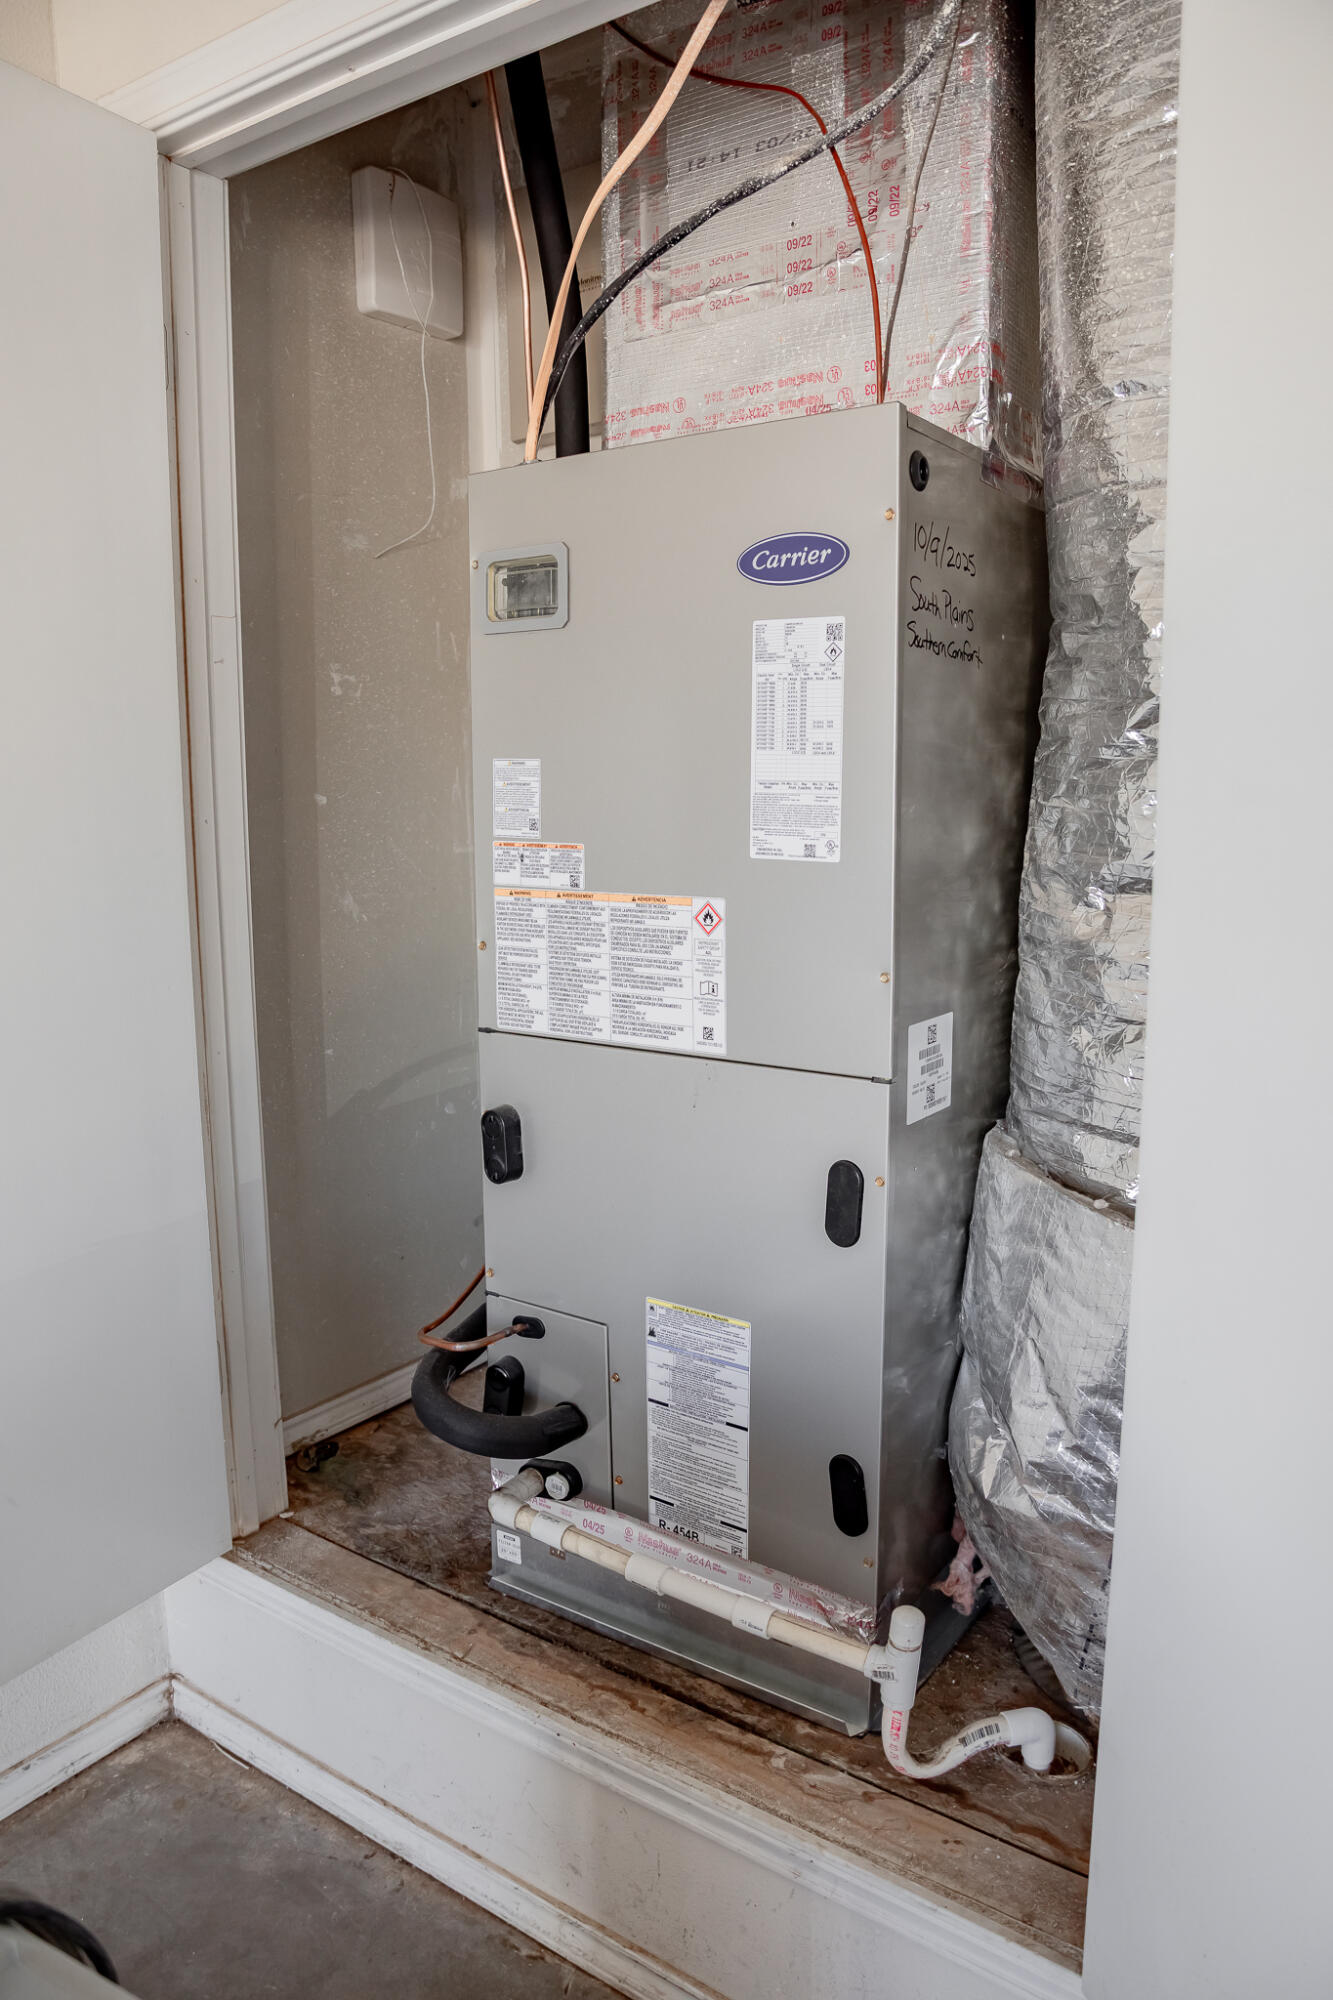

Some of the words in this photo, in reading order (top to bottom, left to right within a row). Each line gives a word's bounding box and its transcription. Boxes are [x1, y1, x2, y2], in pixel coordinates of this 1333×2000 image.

[821, 1, 842, 16] 09/2
[821, 24, 842, 42] 09/2
[867, 189, 878, 222] 09/22
[889, 184, 900, 217] 09/22
[786, 234, 813, 251] 09/22
[709, 273, 735, 289] 324A
[786, 258, 813, 274] 09/22
[709, 295, 735, 312] 324A
[786, 281, 813, 297] 09/22
[928, 399, 961, 416] 324A
[752, 547, 832, 570] Carrier
[912, 521, 976, 577] 10/9/2025
[909, 575, 942, 620] South
[942, 588, 975, 632] Plains
[582, 1518, 606, 1535] 04/25
[686, 1552, 713, 1571] 324A
